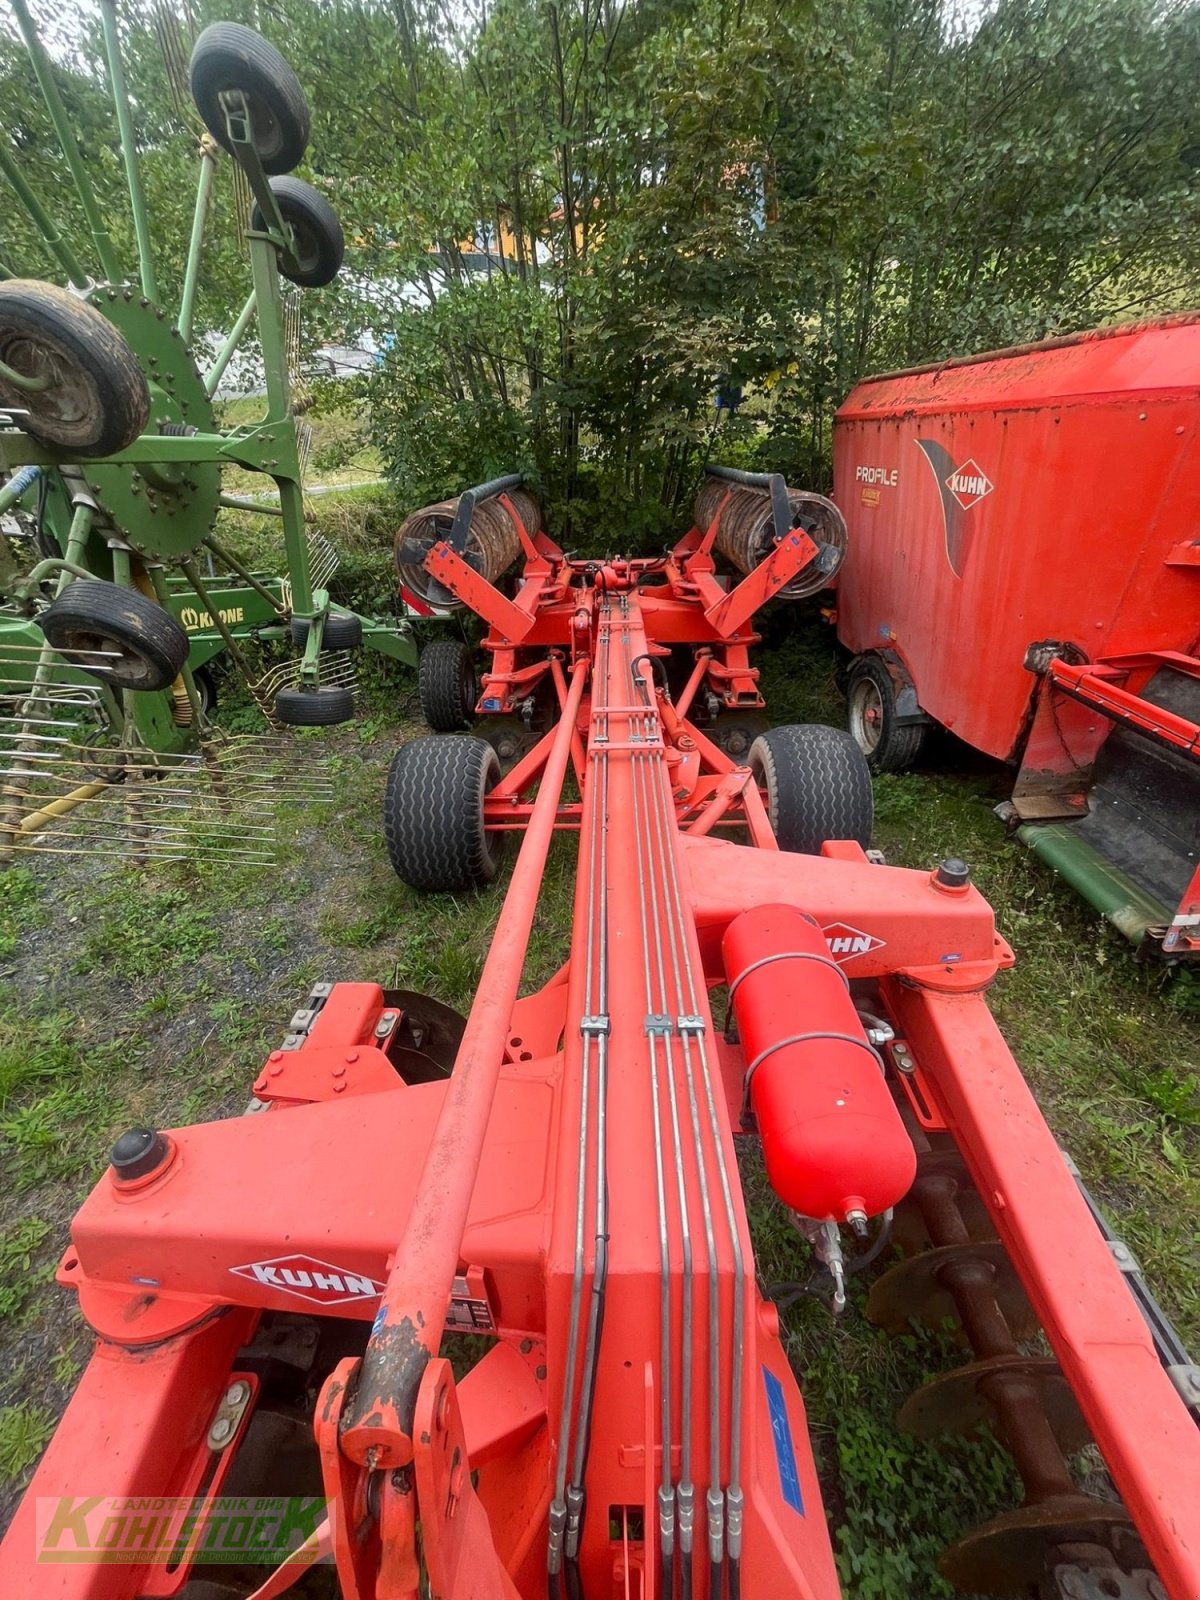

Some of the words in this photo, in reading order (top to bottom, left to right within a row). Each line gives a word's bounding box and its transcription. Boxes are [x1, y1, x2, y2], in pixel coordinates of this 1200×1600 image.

[855, 466, 899, 487] PROFILE
[951, 474, 987, 496] KUHN
[251, 1264, 377, 1295] KUHN
